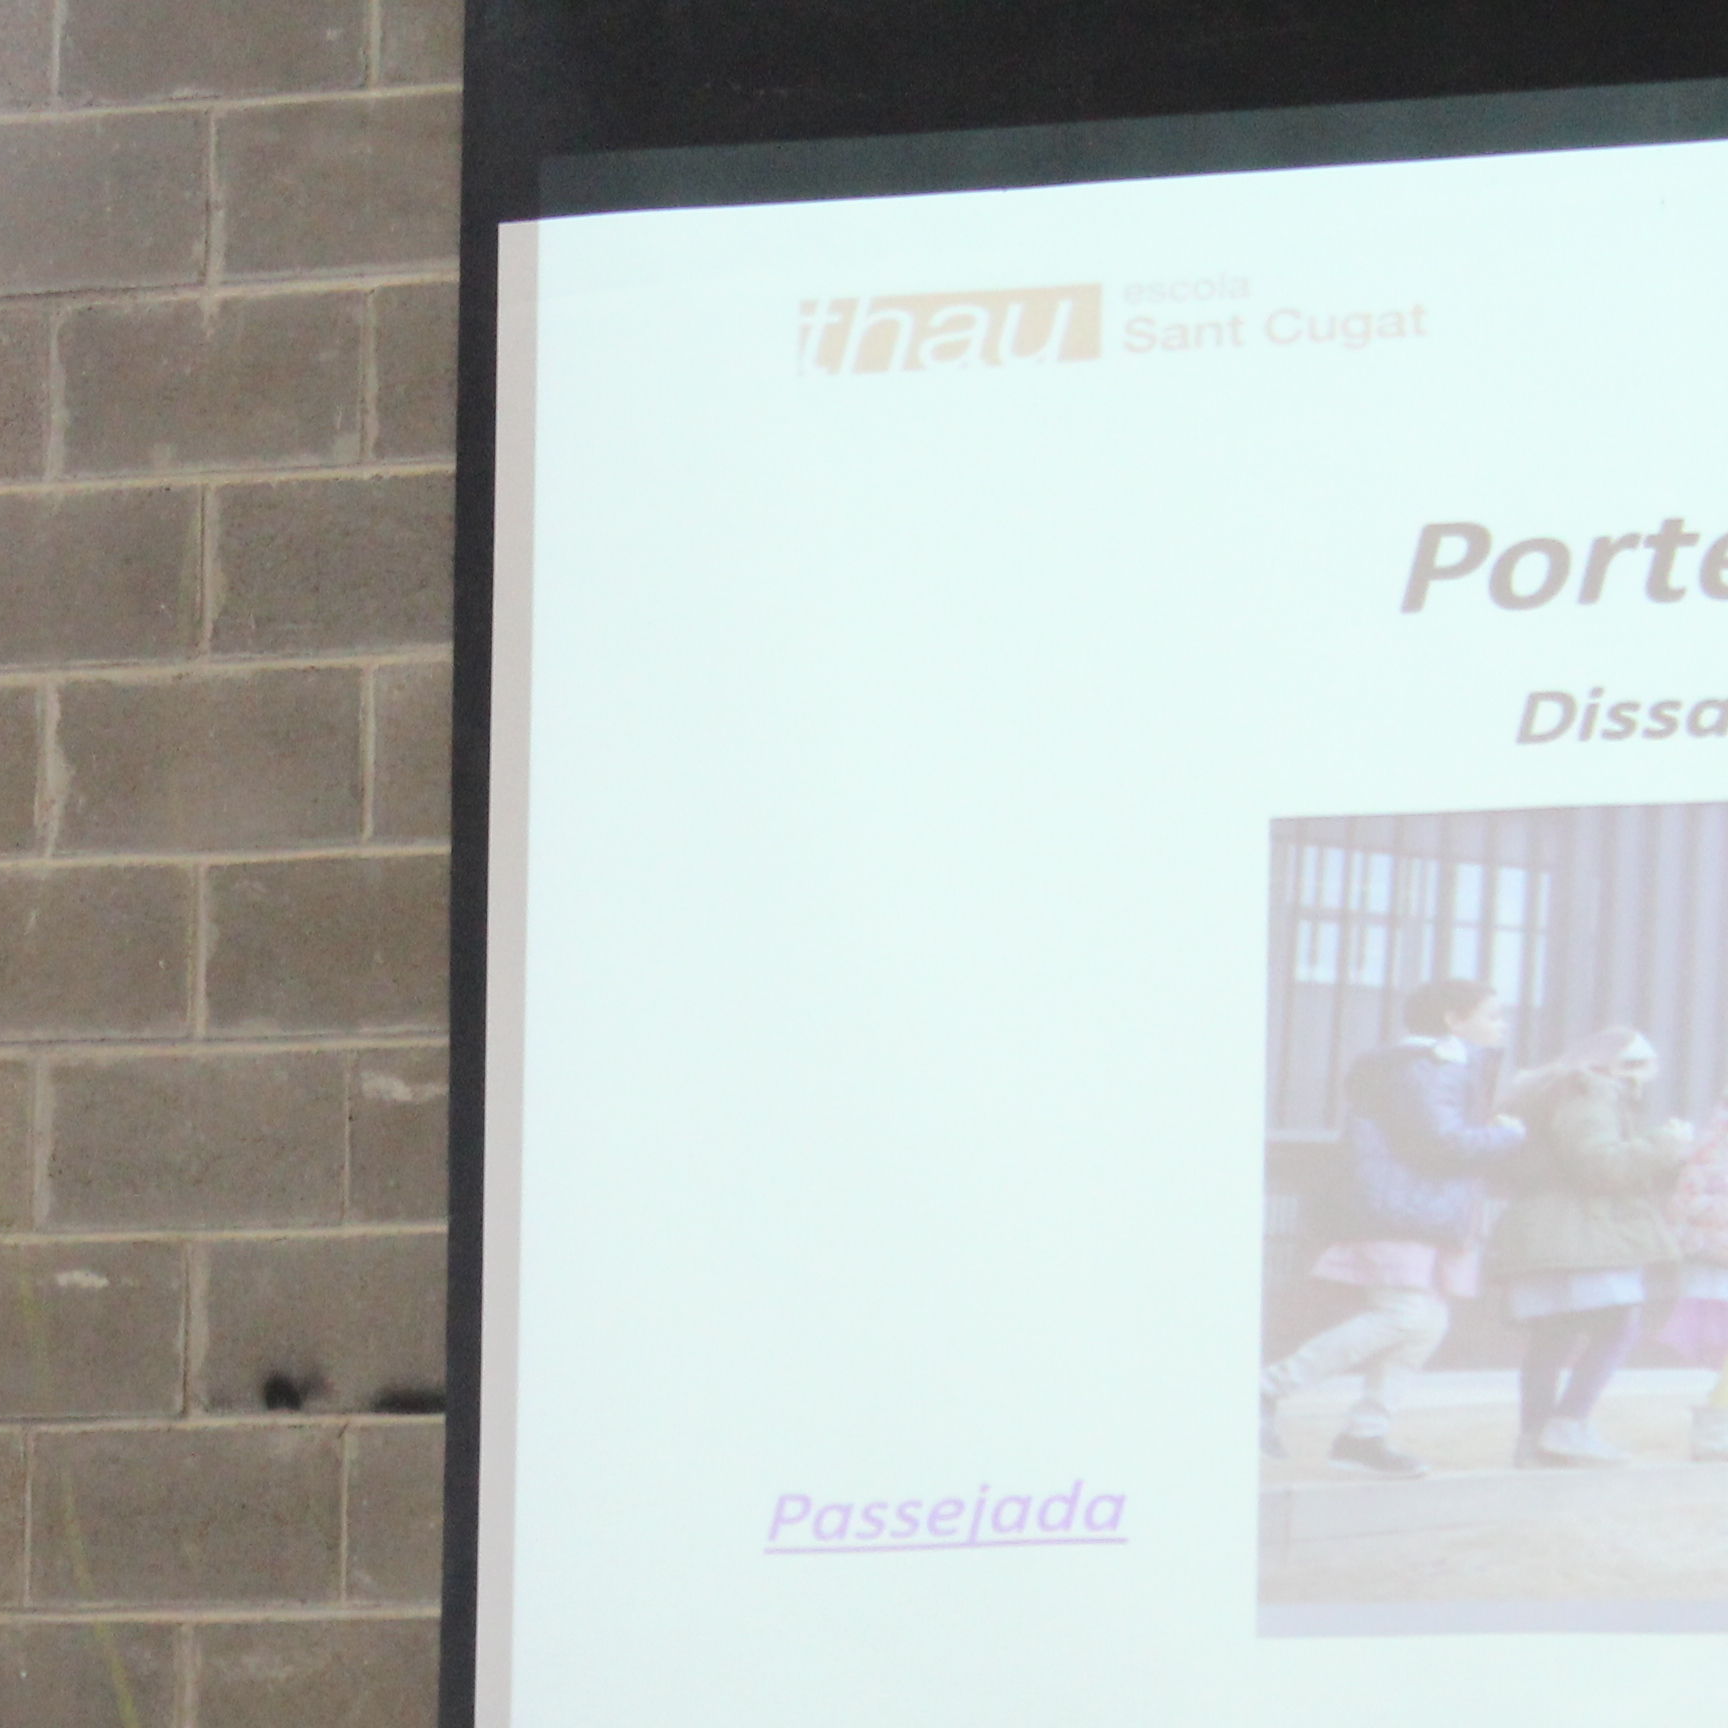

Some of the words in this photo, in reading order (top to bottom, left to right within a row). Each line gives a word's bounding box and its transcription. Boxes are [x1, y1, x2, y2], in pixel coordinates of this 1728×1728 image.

[1120, 271, 1253, 306] escola
[1121, 310, 1246, 355] Sant
[1263, 302, 1429, 351] Cugat
[767, 1478, 1128, 1548] Passejada
